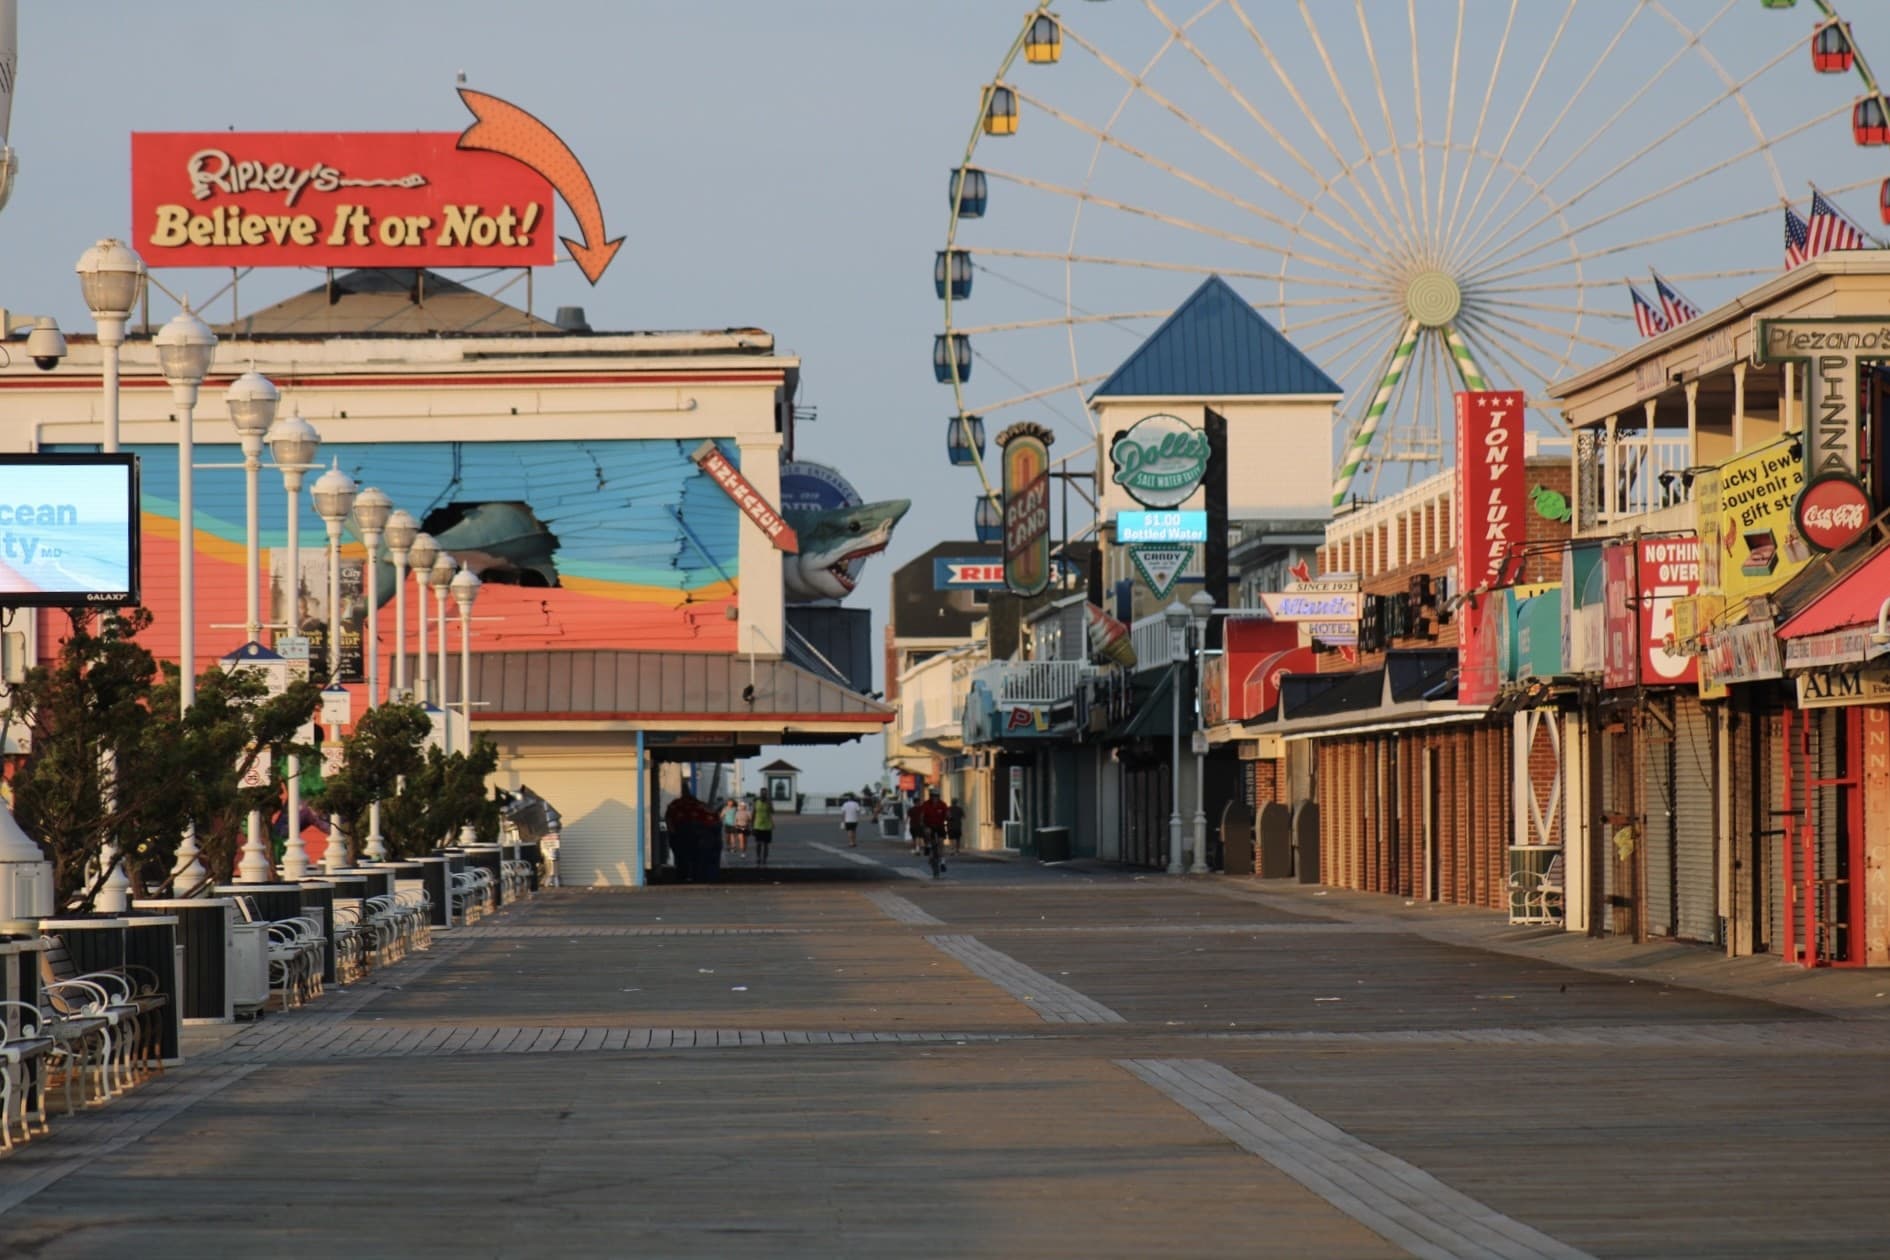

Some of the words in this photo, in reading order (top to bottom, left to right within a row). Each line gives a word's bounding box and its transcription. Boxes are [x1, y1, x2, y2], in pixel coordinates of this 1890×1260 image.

[149, 204, 316, 247] Believe
[327, 204, 372, 247] It
[379, 215, 432, 247] or
[436, 202, 543, 247] Not!
[1815, 356, 1853, 473] PIZZA
[1485, 410, 1510, 481] TONY
[706, 454, 784, 537] ENTRANCE
[1008, 480, 1045, 528] PLAY
[1144, 514, 1180, 526] $1.00
[1741, 501, 1771, 527] gift
[1008, 508, 1047, 551] LAND
[1123, 528, 1166, 541] Bottled
[1168, 528, 1203, 541] Water
[1485, 487, 1511, 576] LUKES
[1143, 553, 1180, 561] CANDY
[1659, 563, 1699, 582] OVER
[86, 593, 124, 601] GALAXY
[1297, 583, 1329, 591] SINCE
[1308, 623, 1355, 634] HOTEL
